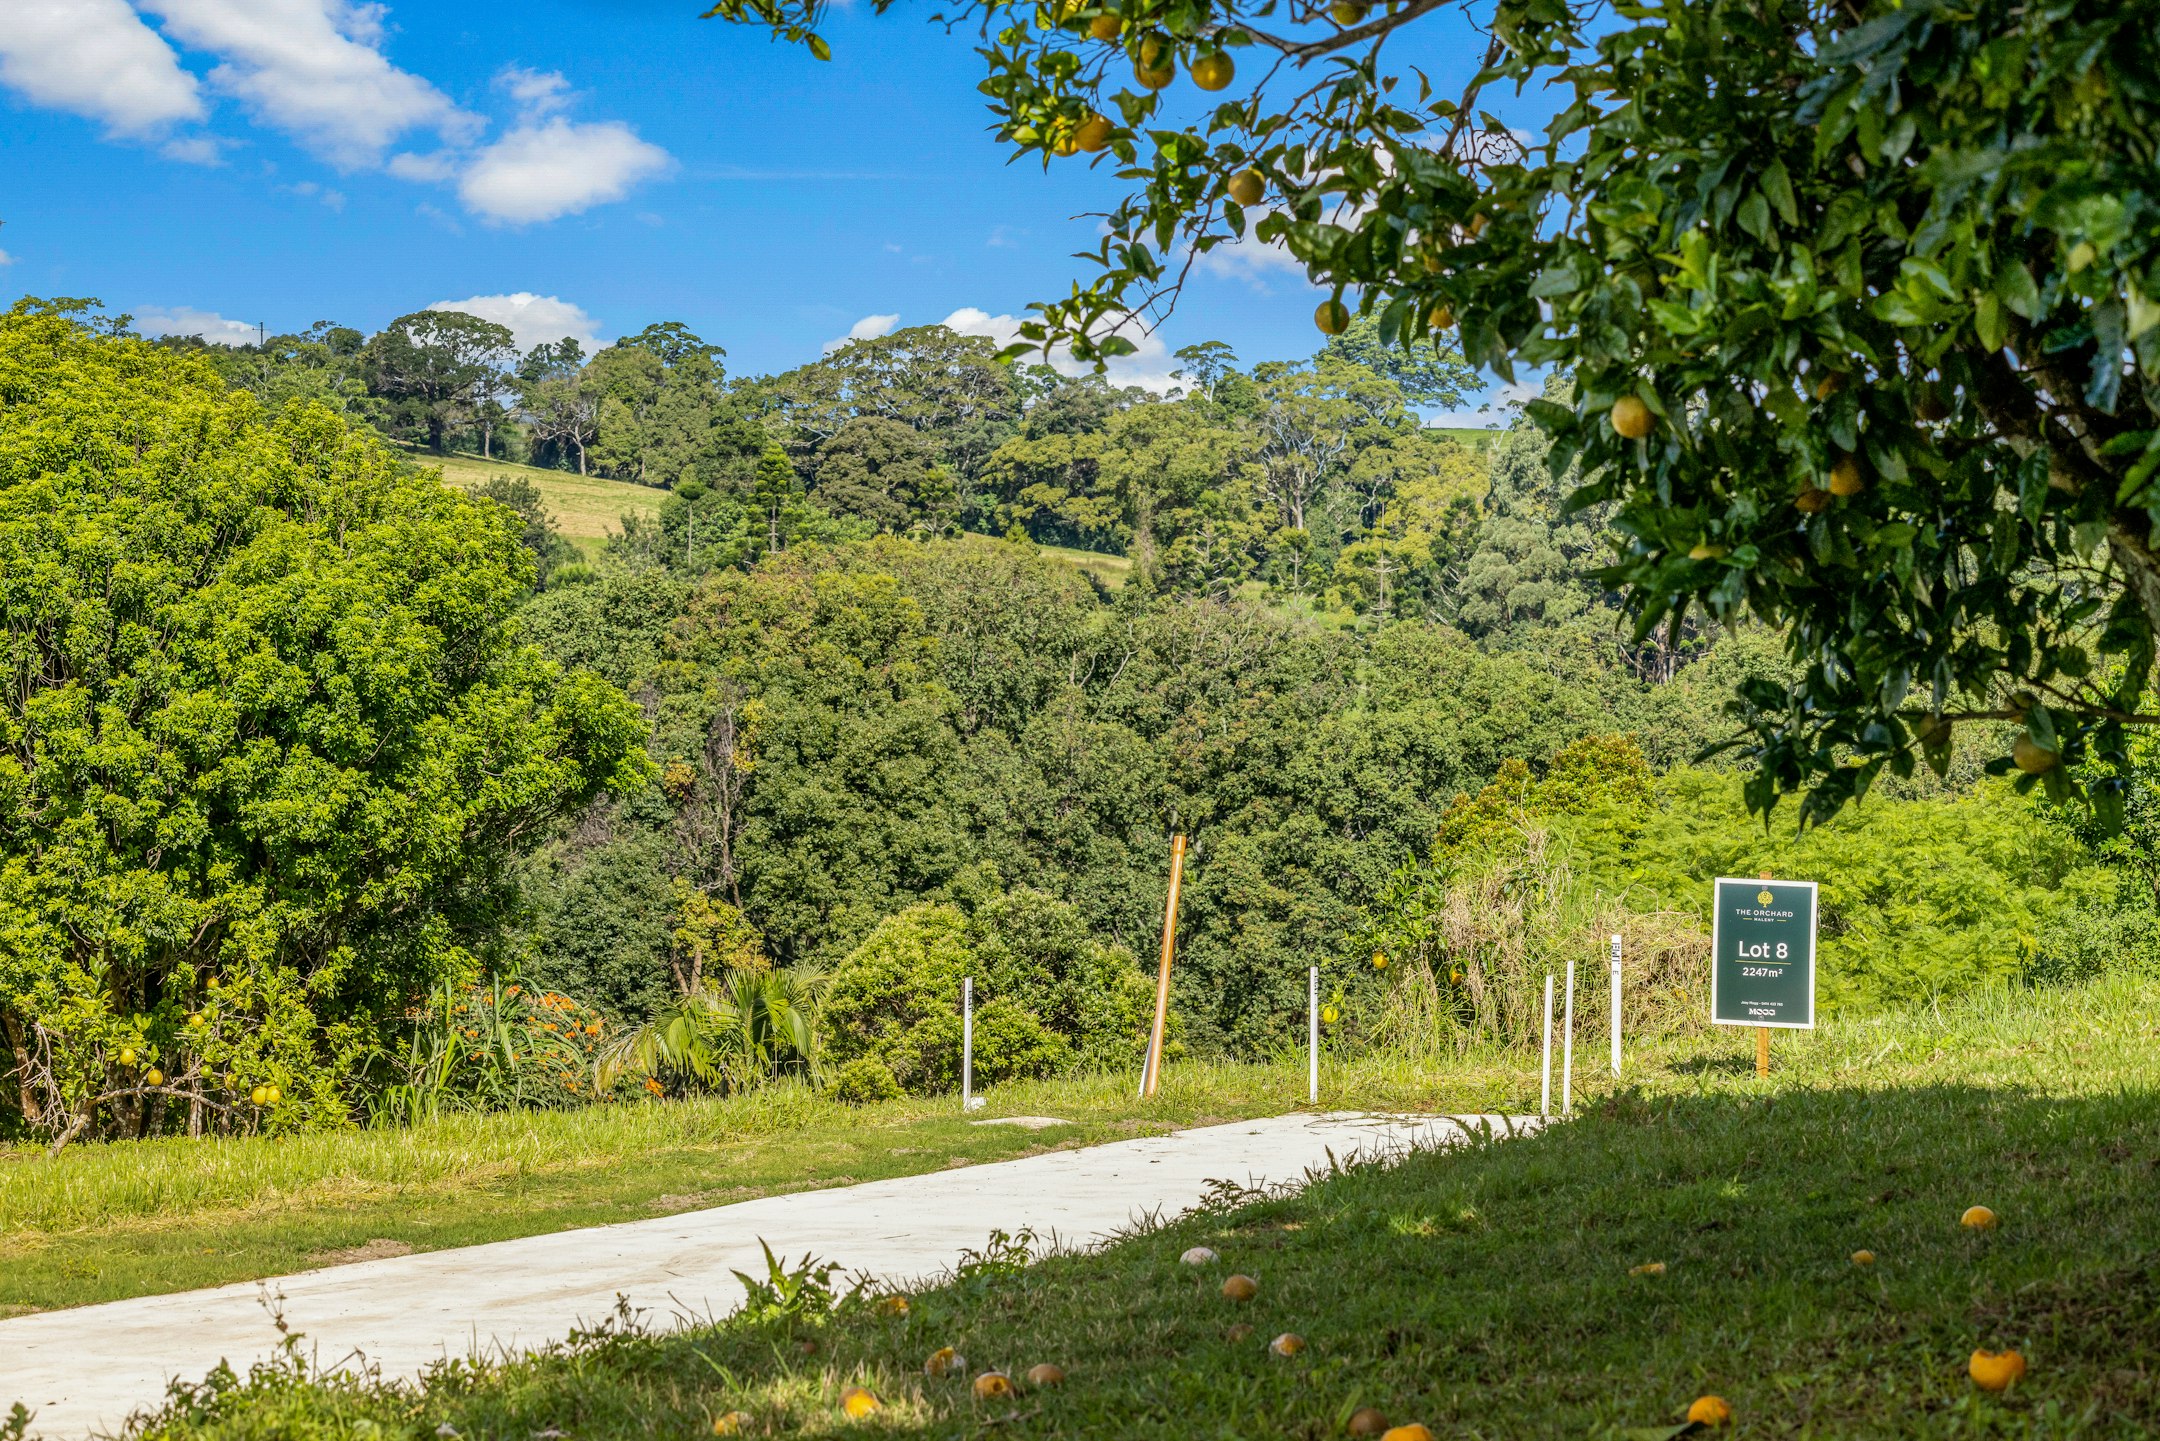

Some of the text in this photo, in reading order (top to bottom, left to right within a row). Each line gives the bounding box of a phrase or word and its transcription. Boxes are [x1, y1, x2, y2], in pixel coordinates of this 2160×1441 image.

[1739, 941, 1788, 959] Lot 8
[1742, 967, 1783, 978] 2247m²
